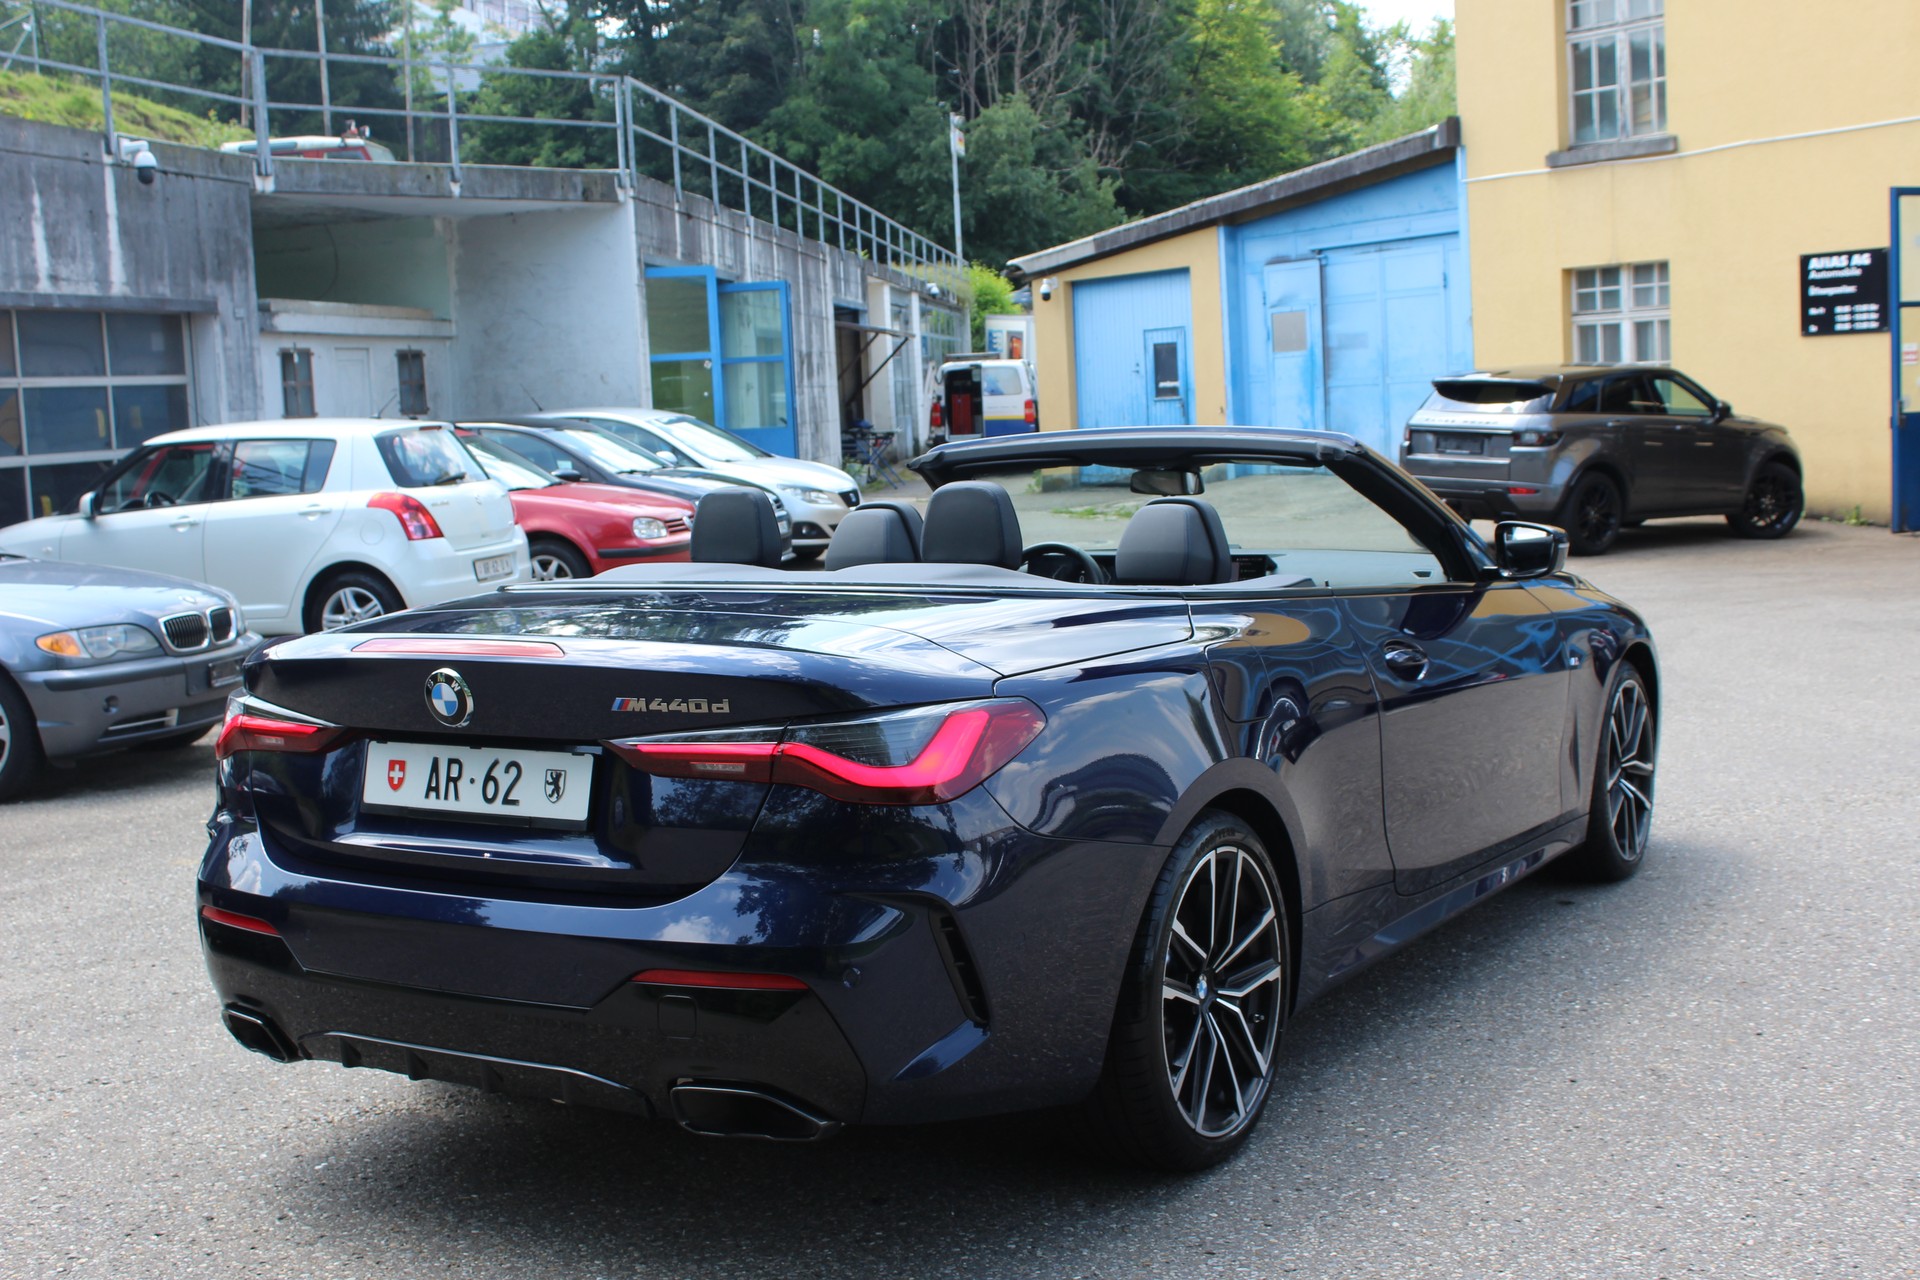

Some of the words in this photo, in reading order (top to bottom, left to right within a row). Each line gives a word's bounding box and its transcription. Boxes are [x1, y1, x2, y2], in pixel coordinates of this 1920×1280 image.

[1850, 253, 1872, 267] AG
[1808, 267, 1862, 280] Automobile
[628, 697, 730, 714] M440d
